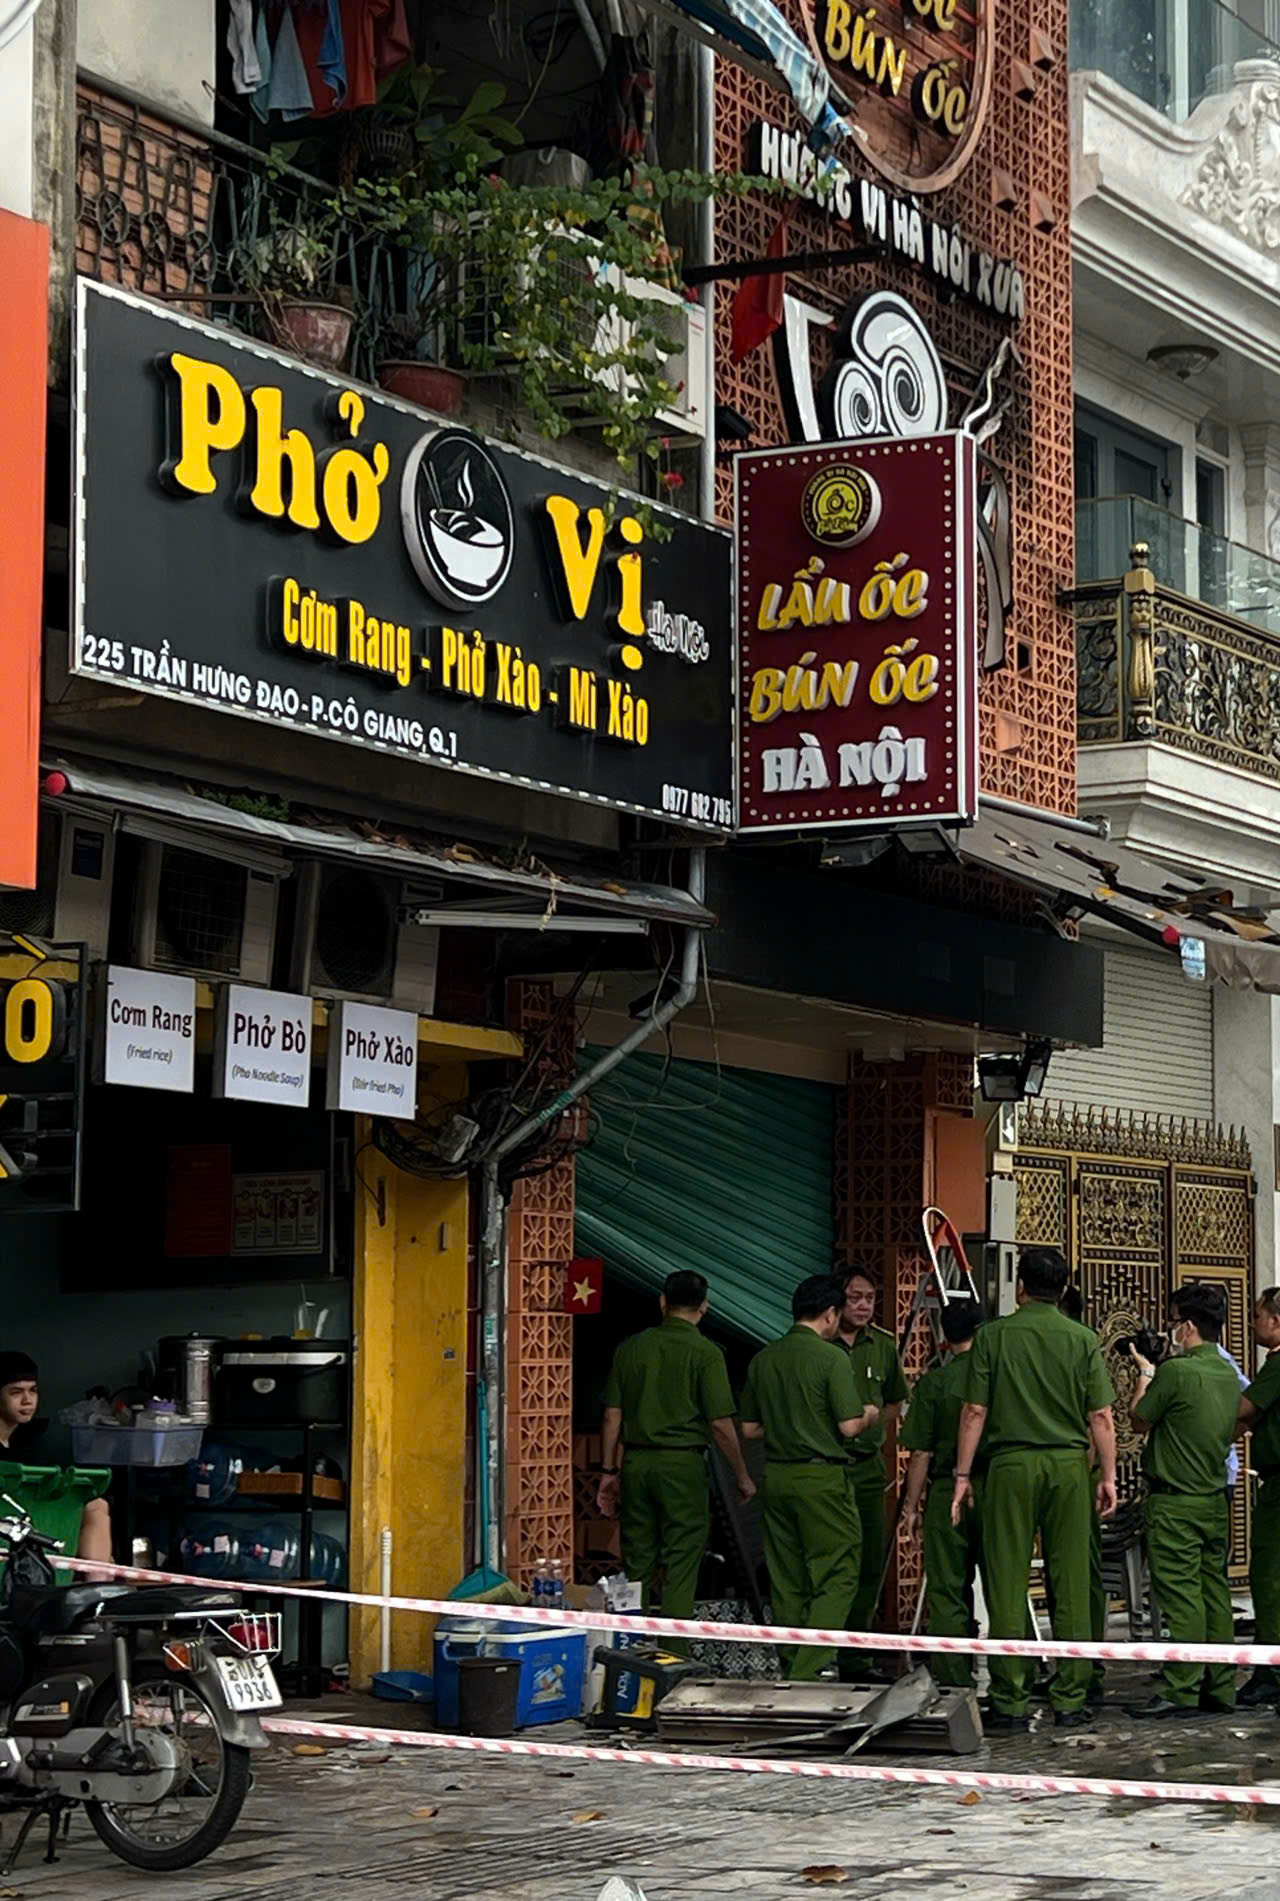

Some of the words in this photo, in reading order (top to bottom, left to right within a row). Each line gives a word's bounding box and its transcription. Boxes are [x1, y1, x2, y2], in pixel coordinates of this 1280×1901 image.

[822, 0, 907, 96] BÚN
[921, 59, 967, 135] ỐC
[892, 195, 925, 265] HÀ
[170, 352, 389, 546] Phở
[545, 494, 646, 671] Vị
[757, 555, 851, 632] LẨU
[858, 551, 930, 620] ỐC
[84, 633, 126, 671] 225
[131, 639, 187, 687] TRẦN
[192, 664, 251, 702] HƯNG
[283, 577, 338, 657] Cơm
[349, 599, 411, 688] Rang
[442, 626, 487, 699] Phở
[496, 642, 541, 713] Xào
[569, 667, 597, 731] Mì
[608, 679, 649, 747] Xào
[749, 650, 859, 723] BÚN
[868, 636, 940, 706] ỐC
[761, 732, 831, 794] HÀ
[837, 725, 927, 799] NỘI
[110, 997, 147, 1028] Cơm
[152, 1004, 193, 1038] Rang
[233, 1012, 277, 1050] Phở
[281, 1019, 307, 1054] Bò
[345, 1029, 381, 1061] Phở
[383, 1034, 414, 1067] Xào
